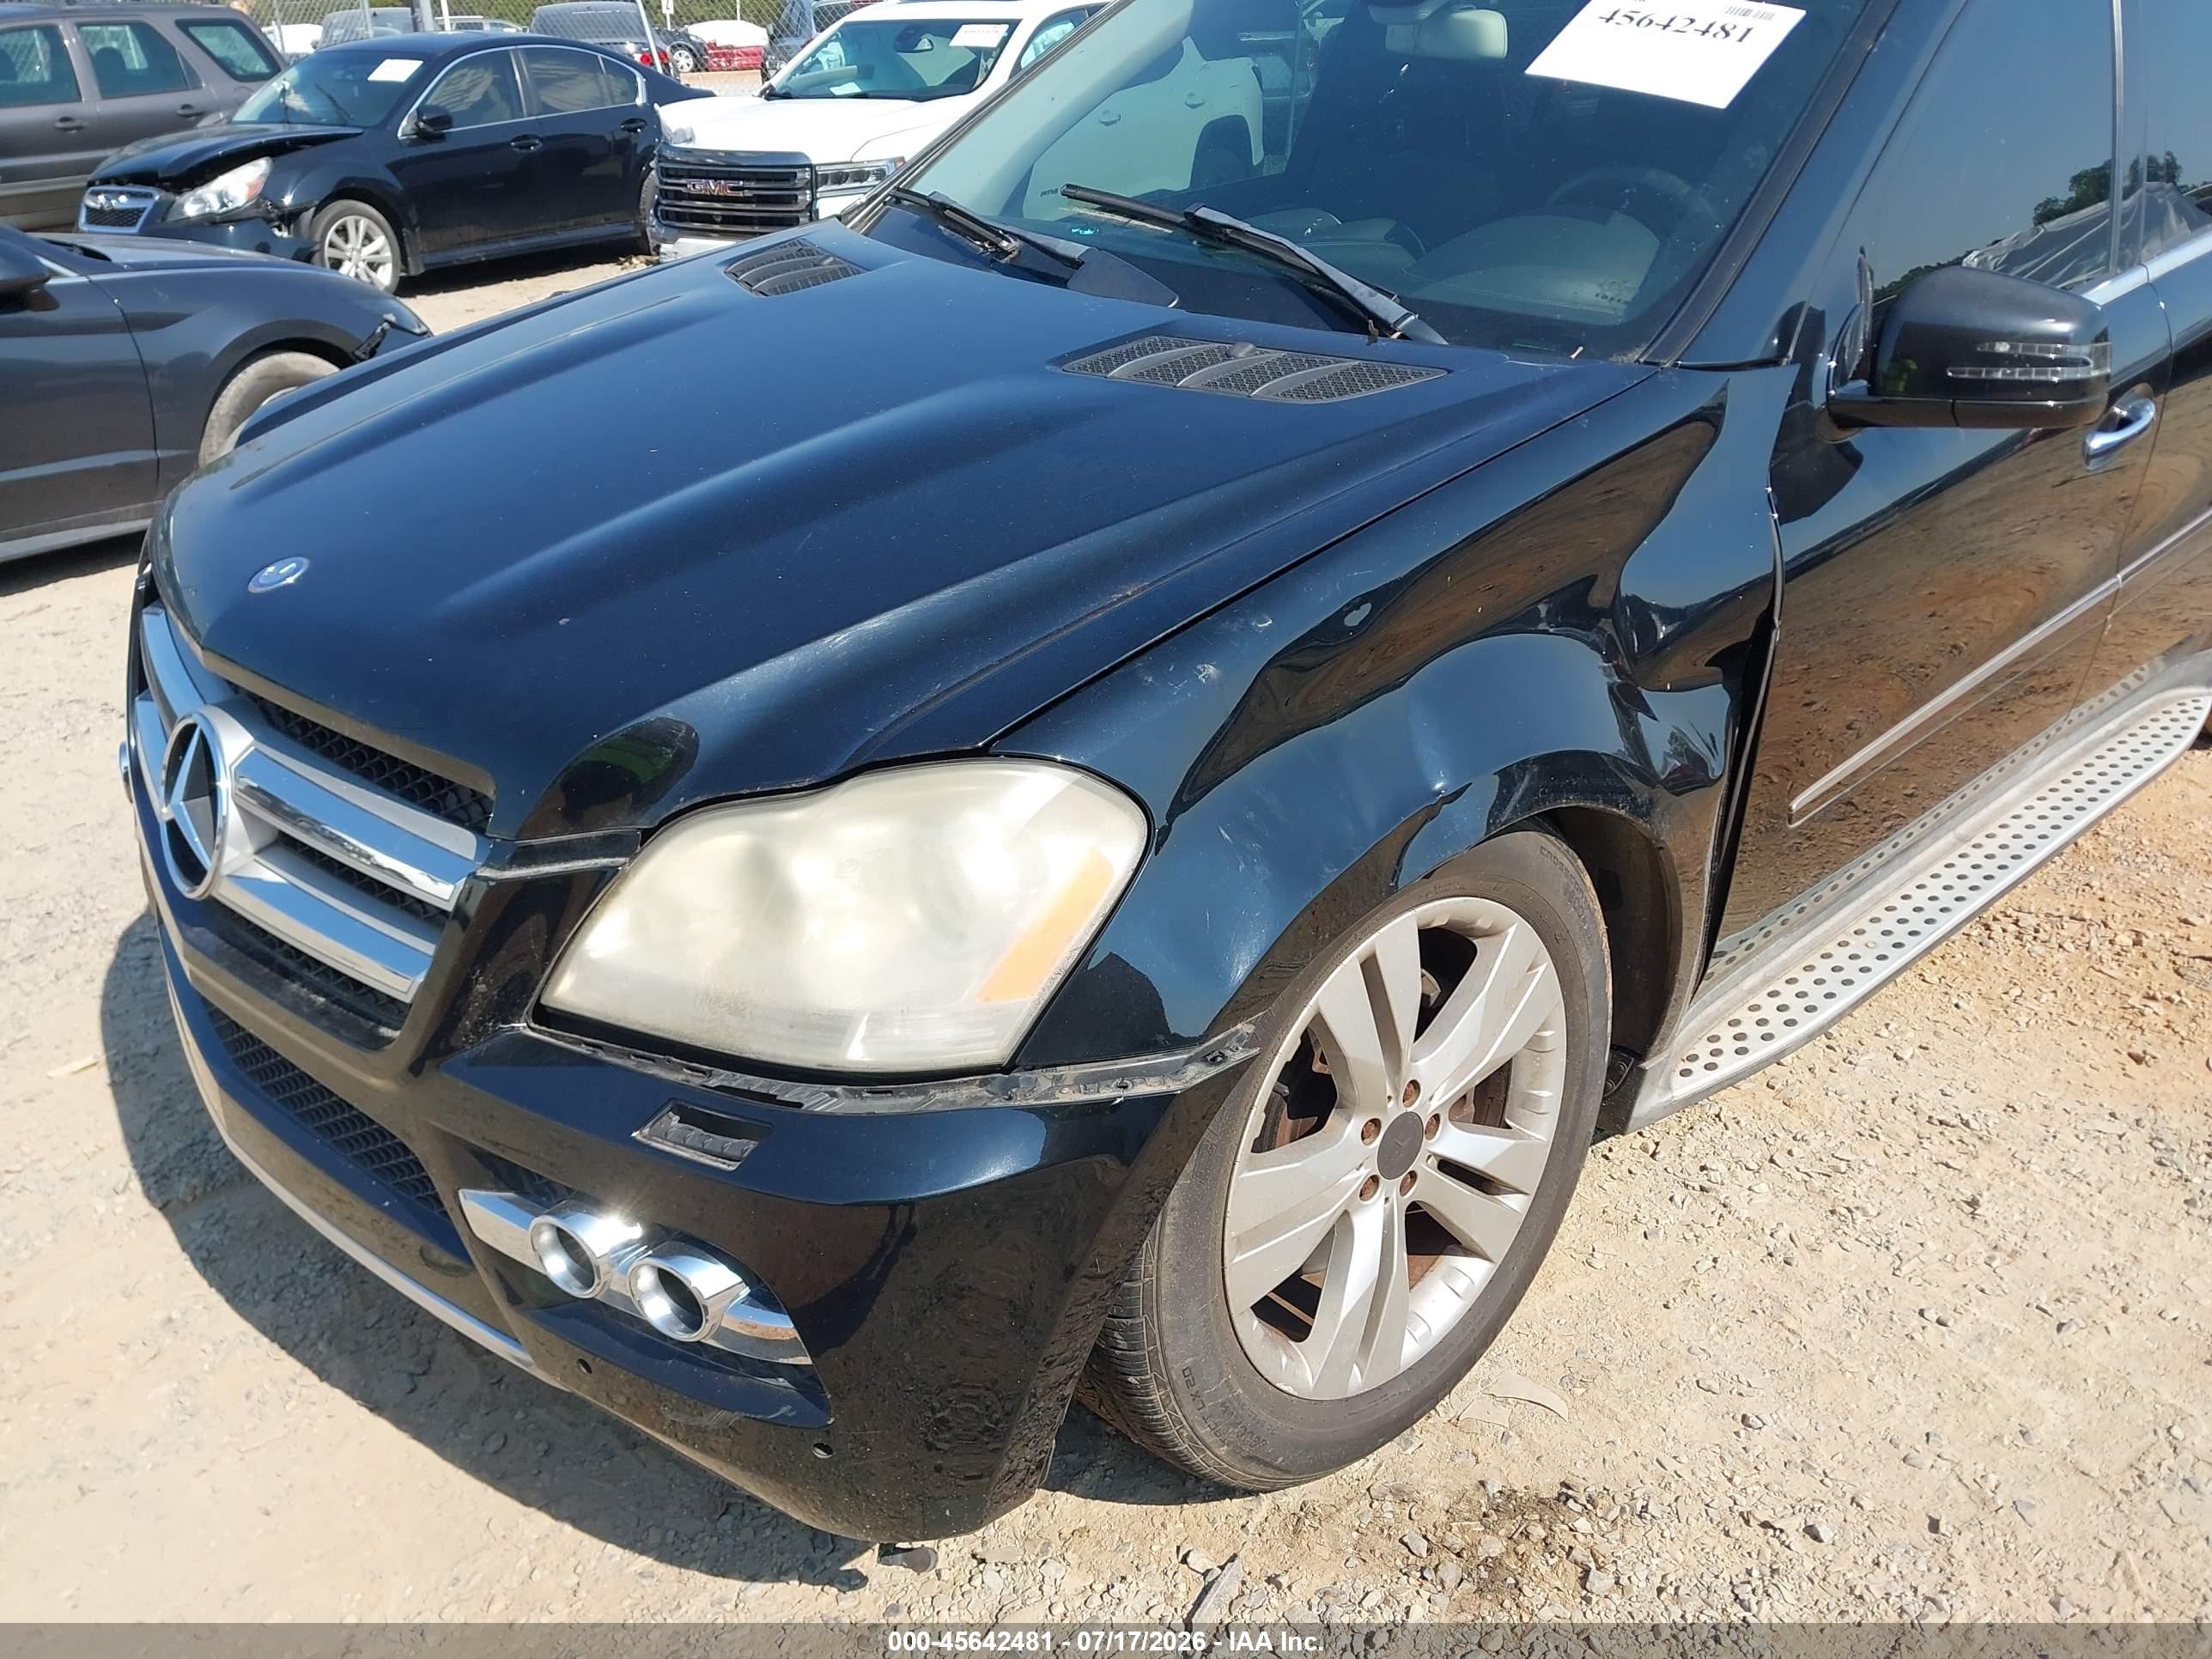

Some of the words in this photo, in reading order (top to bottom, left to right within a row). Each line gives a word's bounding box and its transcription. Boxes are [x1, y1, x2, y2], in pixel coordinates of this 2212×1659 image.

[1598, 8, 1753, 43] 45642481
[688, 179, 744, 197] GMC
[1182, 1365, 1196, 1389] 20
[1190, 1390, 1206, 1412] LX
